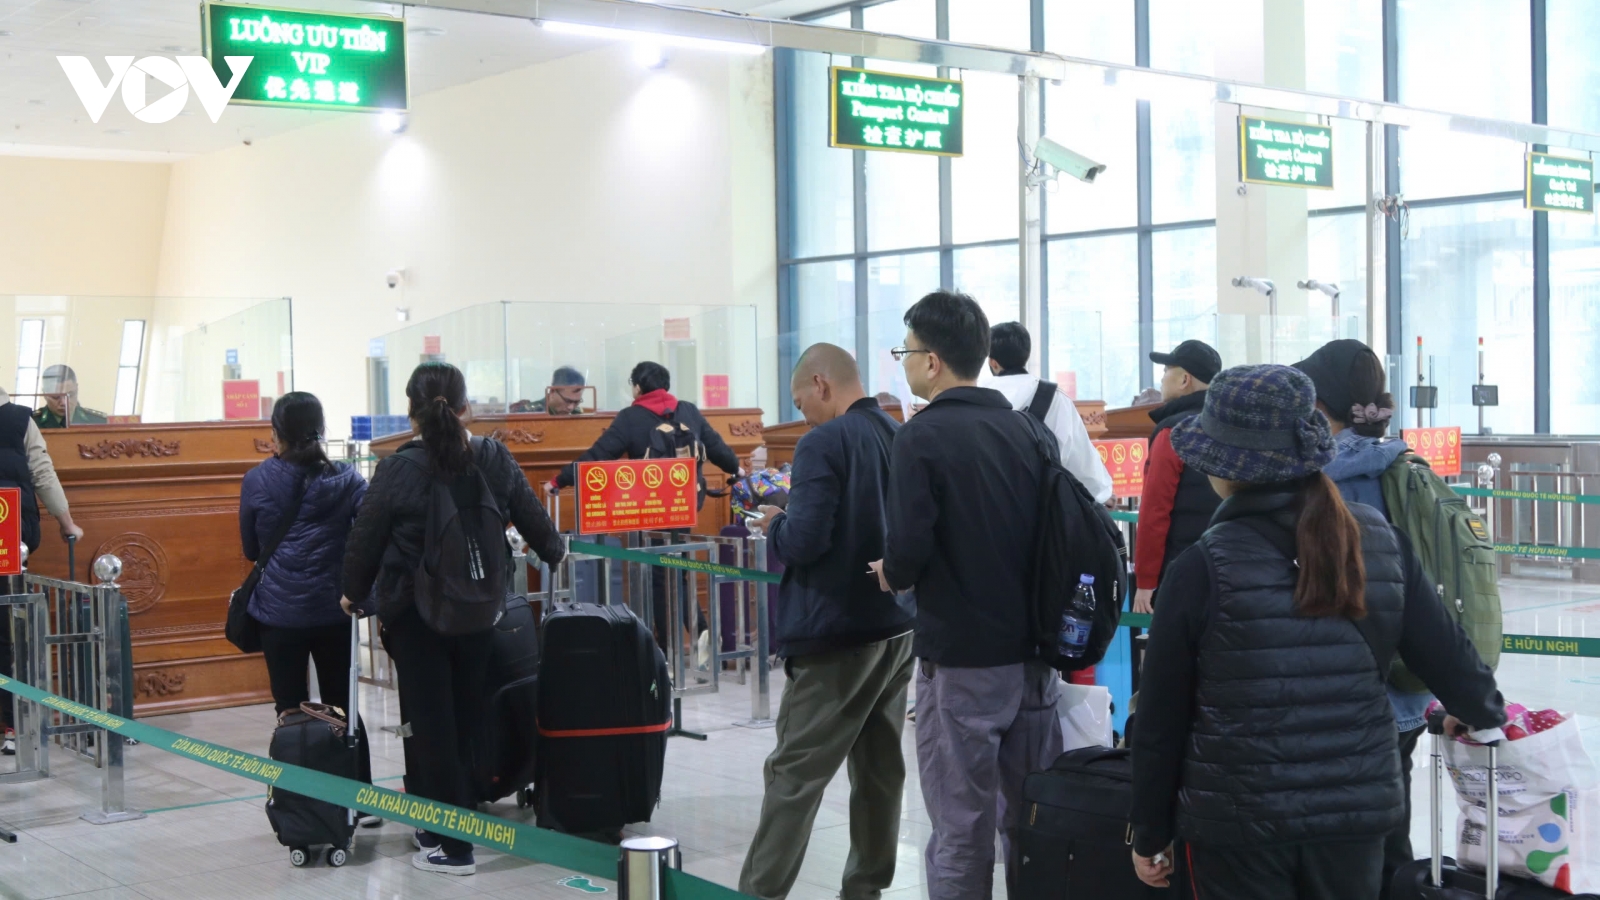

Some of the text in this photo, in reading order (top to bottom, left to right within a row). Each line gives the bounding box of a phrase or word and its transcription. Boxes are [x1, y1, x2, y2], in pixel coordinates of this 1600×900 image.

[292, 52, 330, 74] VIP
[852, 101, 949, 124] Passport Control
[1502, 636, 1579, 655] Ế HỮU NGHỊ
[171, 738, 191, 751] CỬA
[239, 758, 262, 774] HỮU
[257, 763, 283, 783] NGHỊ
[356, 787, 379, 807] CỬA
[457, 812, 485, 837] HỮU
[484, 820, 516, 850] NGHỊ
